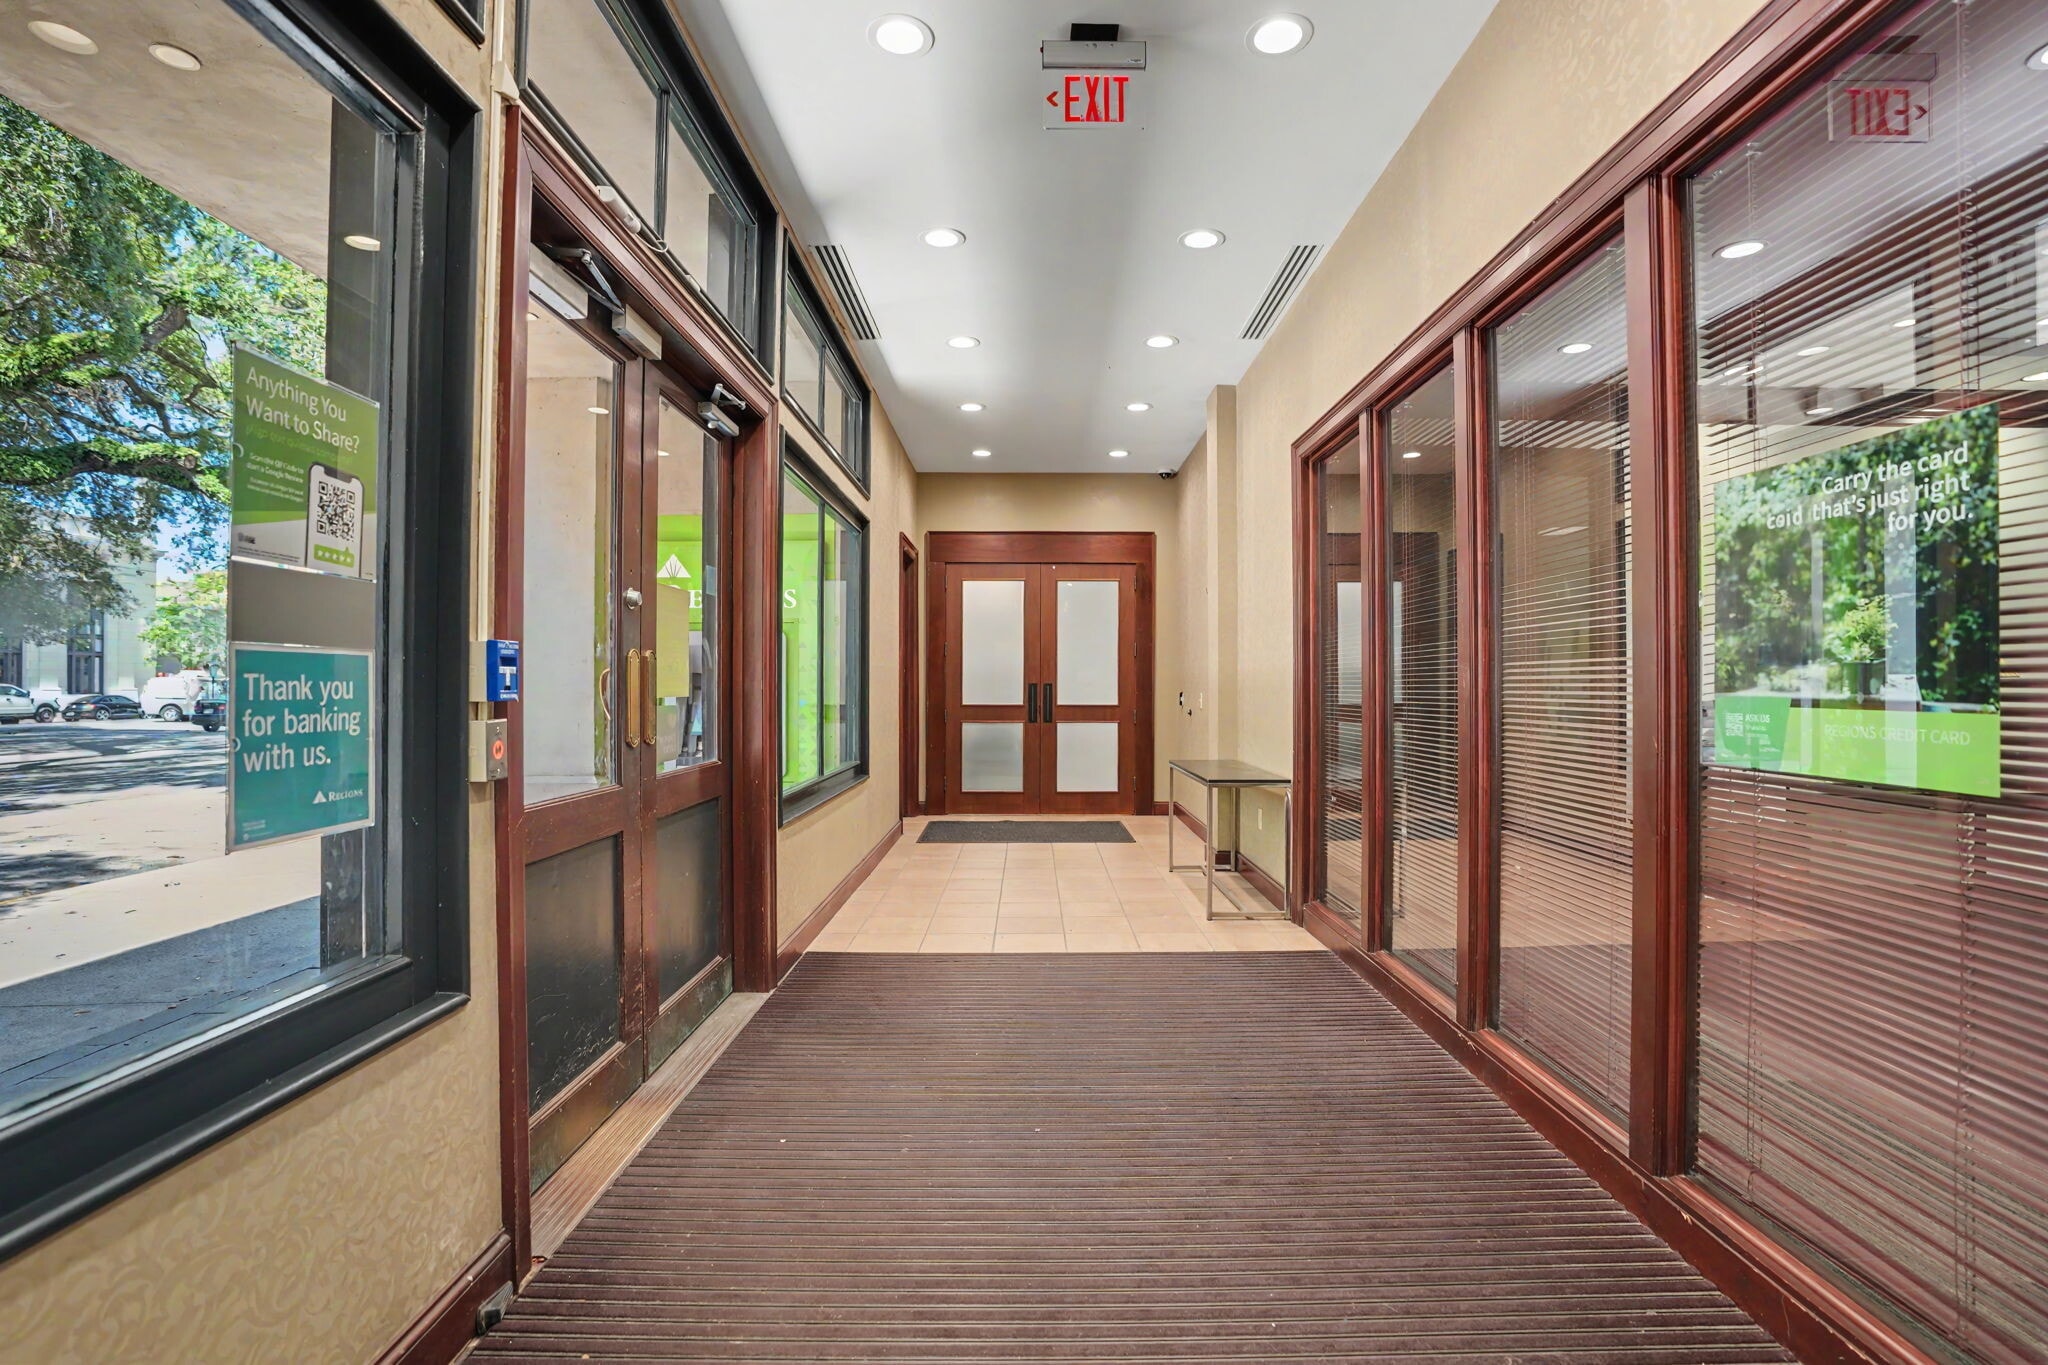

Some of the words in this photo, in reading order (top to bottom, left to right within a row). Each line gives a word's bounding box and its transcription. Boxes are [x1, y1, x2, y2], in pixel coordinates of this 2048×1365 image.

[1064, 76, 1129, 122] EXIT
[246, 366, 319, 416] Anything
[320, 397, 347, 422] You
[246, 396, 291, 431] Want
[293, 415, 310, 436] to
[312, 421, 360, 454] Share?
[1822, 468, 1873, 495] Carry
[1878, 459, 1912, 482] the
[1917, 440, 1969, 473] card
[1812, 494, 1866, 521] that's
[1867, 489, 1910, 516] just
[1914, 471, 1971, 503] right
[1888, 510, 1919, 533] for
[1923, 502, 1974, 533] you.
[243, 673, 314, 701] Thank
[319, 680, 354, 706] you
[242, 709, 276, 737] for
[284, 706, 361, 736] banking
[1824, 724, 1877, 740] REGIONS
[1880, 727, 1928, 743] CREDIT
[1930, 729, 1971, 746] CARD
[243, 742, 295, 773] with
[303, 744, 332, 767] us.
